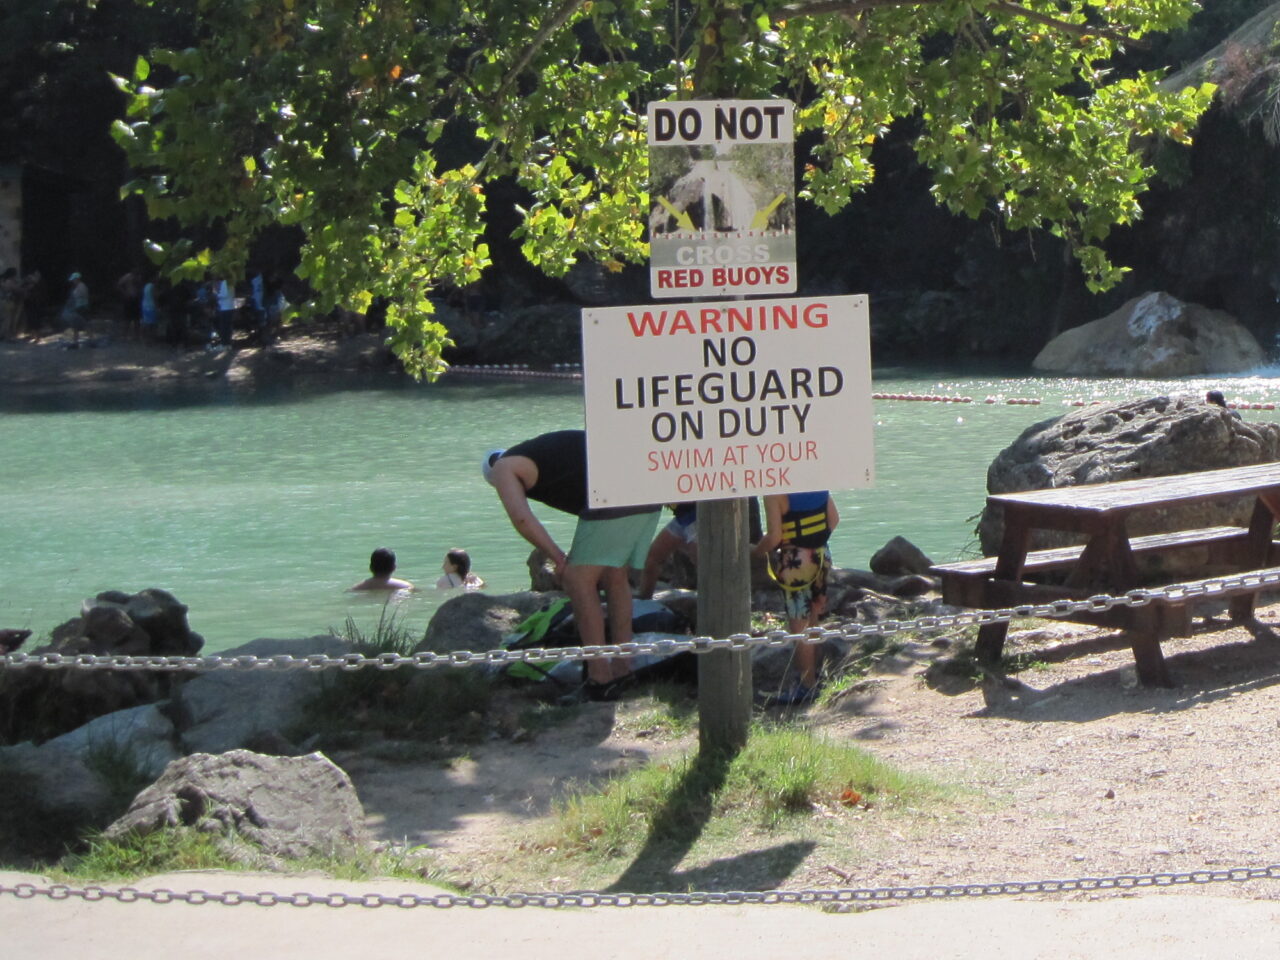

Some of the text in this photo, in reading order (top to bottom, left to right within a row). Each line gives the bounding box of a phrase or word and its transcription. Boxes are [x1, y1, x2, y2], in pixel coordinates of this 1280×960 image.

[654, 106, 785, 141] DO NOT
[676, 244, 770, 266] CROSS
[658, 265, 790, 289] RED BUOYS
[627, 303, 829, 337] WARNING
[703, 336, 756, 367] NO
[616, 366, 844, 409] LIFEGUARD
[652, 404, 811, 442] ON DUTY
[648, 441, 818, 472] SWIM AT YOUR
[677, 467, 791, 494] OWN RISK
